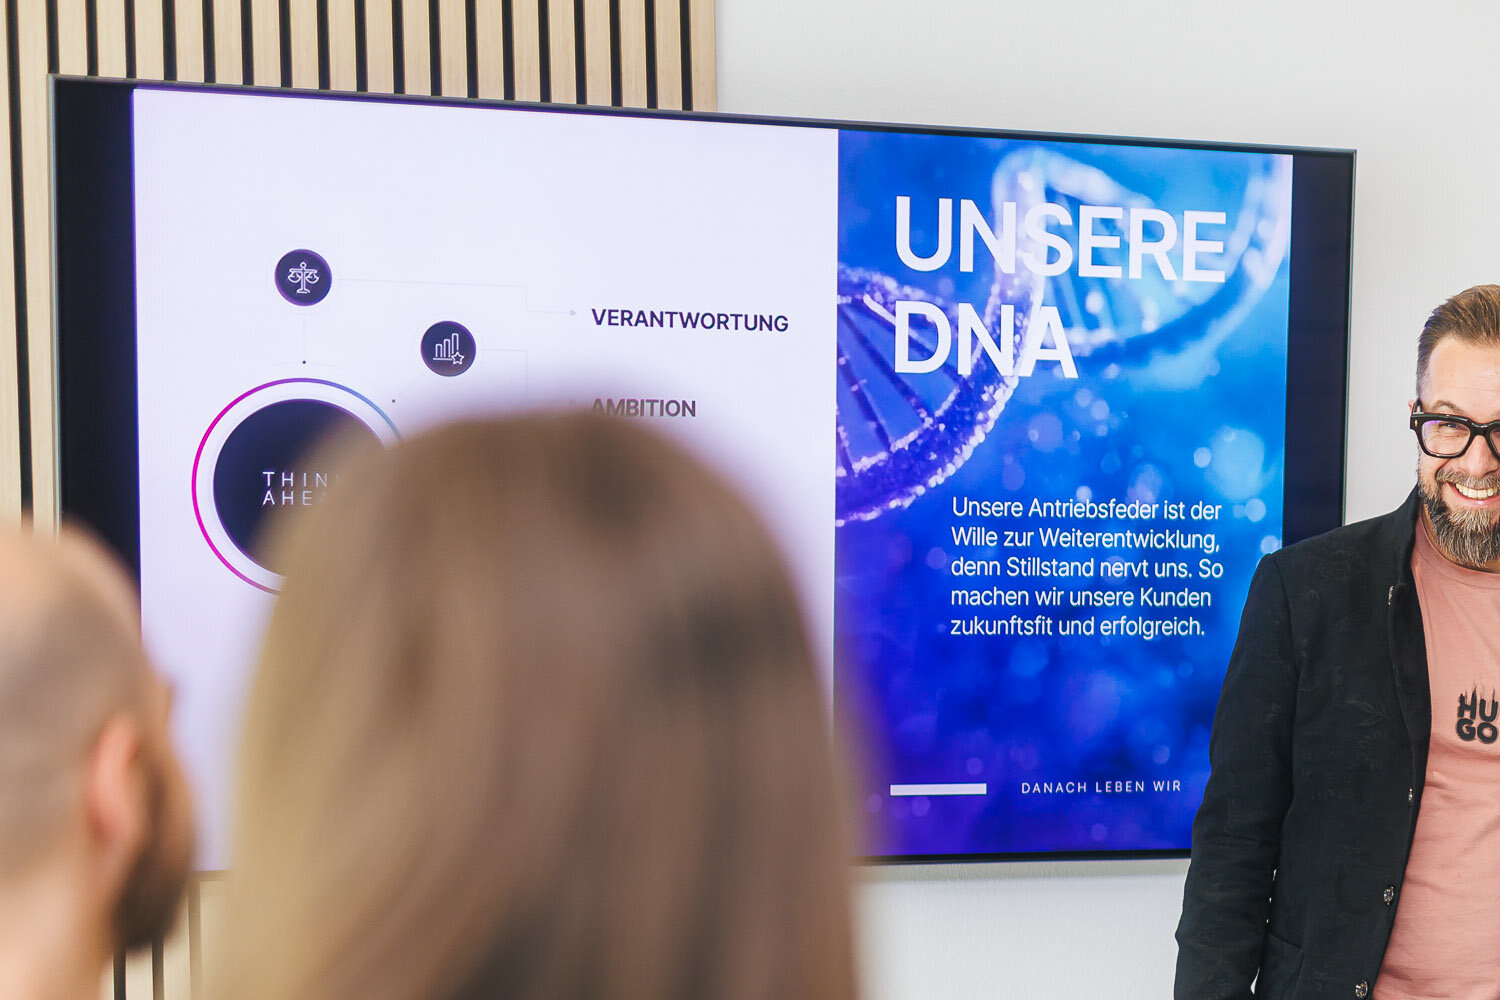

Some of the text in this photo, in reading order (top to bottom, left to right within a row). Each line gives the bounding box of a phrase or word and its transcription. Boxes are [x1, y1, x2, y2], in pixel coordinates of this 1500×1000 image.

[895, 195, 1227, 283] UNSERE
[591, 308, 789, 332] VERANTWORTUNG
[894, 300, 1079, 379] DNA
[592, 397, 696, 418] AMBITION
[262, 471, 328, 488] THIN
[952, 497, 1222, 520] Unsere Antriebsfeder ist der
[951, 526, 1221, 553] Wille zur Weiterentwicklung,
[951, 556, 1224, 578] denn Stillstand nervt uns. So
[951, 586, 1212, 608] machen wir unsere Kunden
[950, 615, 1205, 640] zukunftsfit und erfolgreich.
[1021, 780, 1181, 794] DANACH LEBEN WIR
